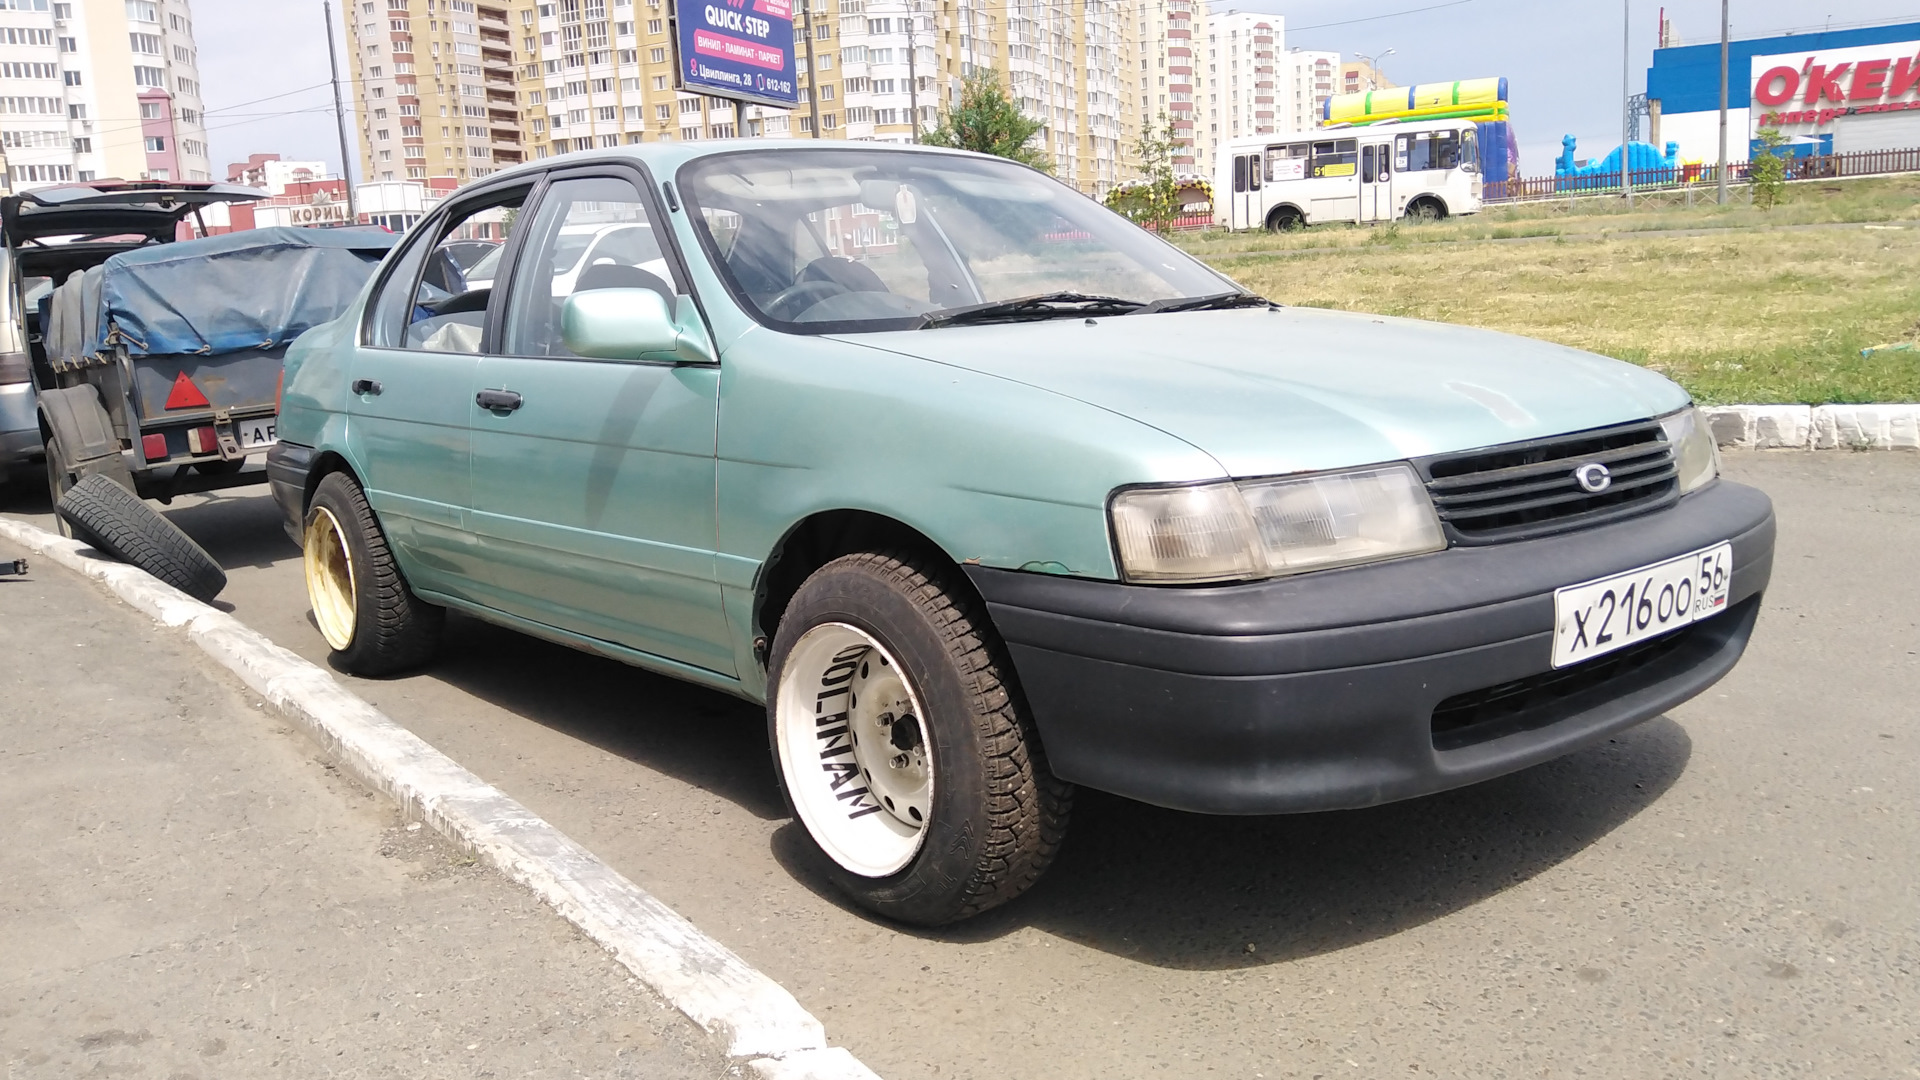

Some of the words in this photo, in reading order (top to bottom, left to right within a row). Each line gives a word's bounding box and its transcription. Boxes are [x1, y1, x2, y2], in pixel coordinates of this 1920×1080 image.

[705, 4, 743, 32] QUICK
[745, 16, 770, 38] STEP
[697, 35, 721, 51] ВИНИЛ
[725, 42, 754, 58] ЛАМИНАТ
[758, 50, 781, 64] ПАРКЕТ
[743, 73, 752, 86] 28
[766, 78, 791, 94] 612-162
[1314, 167, 1325, 176] 51
[1700, 552, 1724, 596] 56
[1695, 594, 1714, 612] RUS
